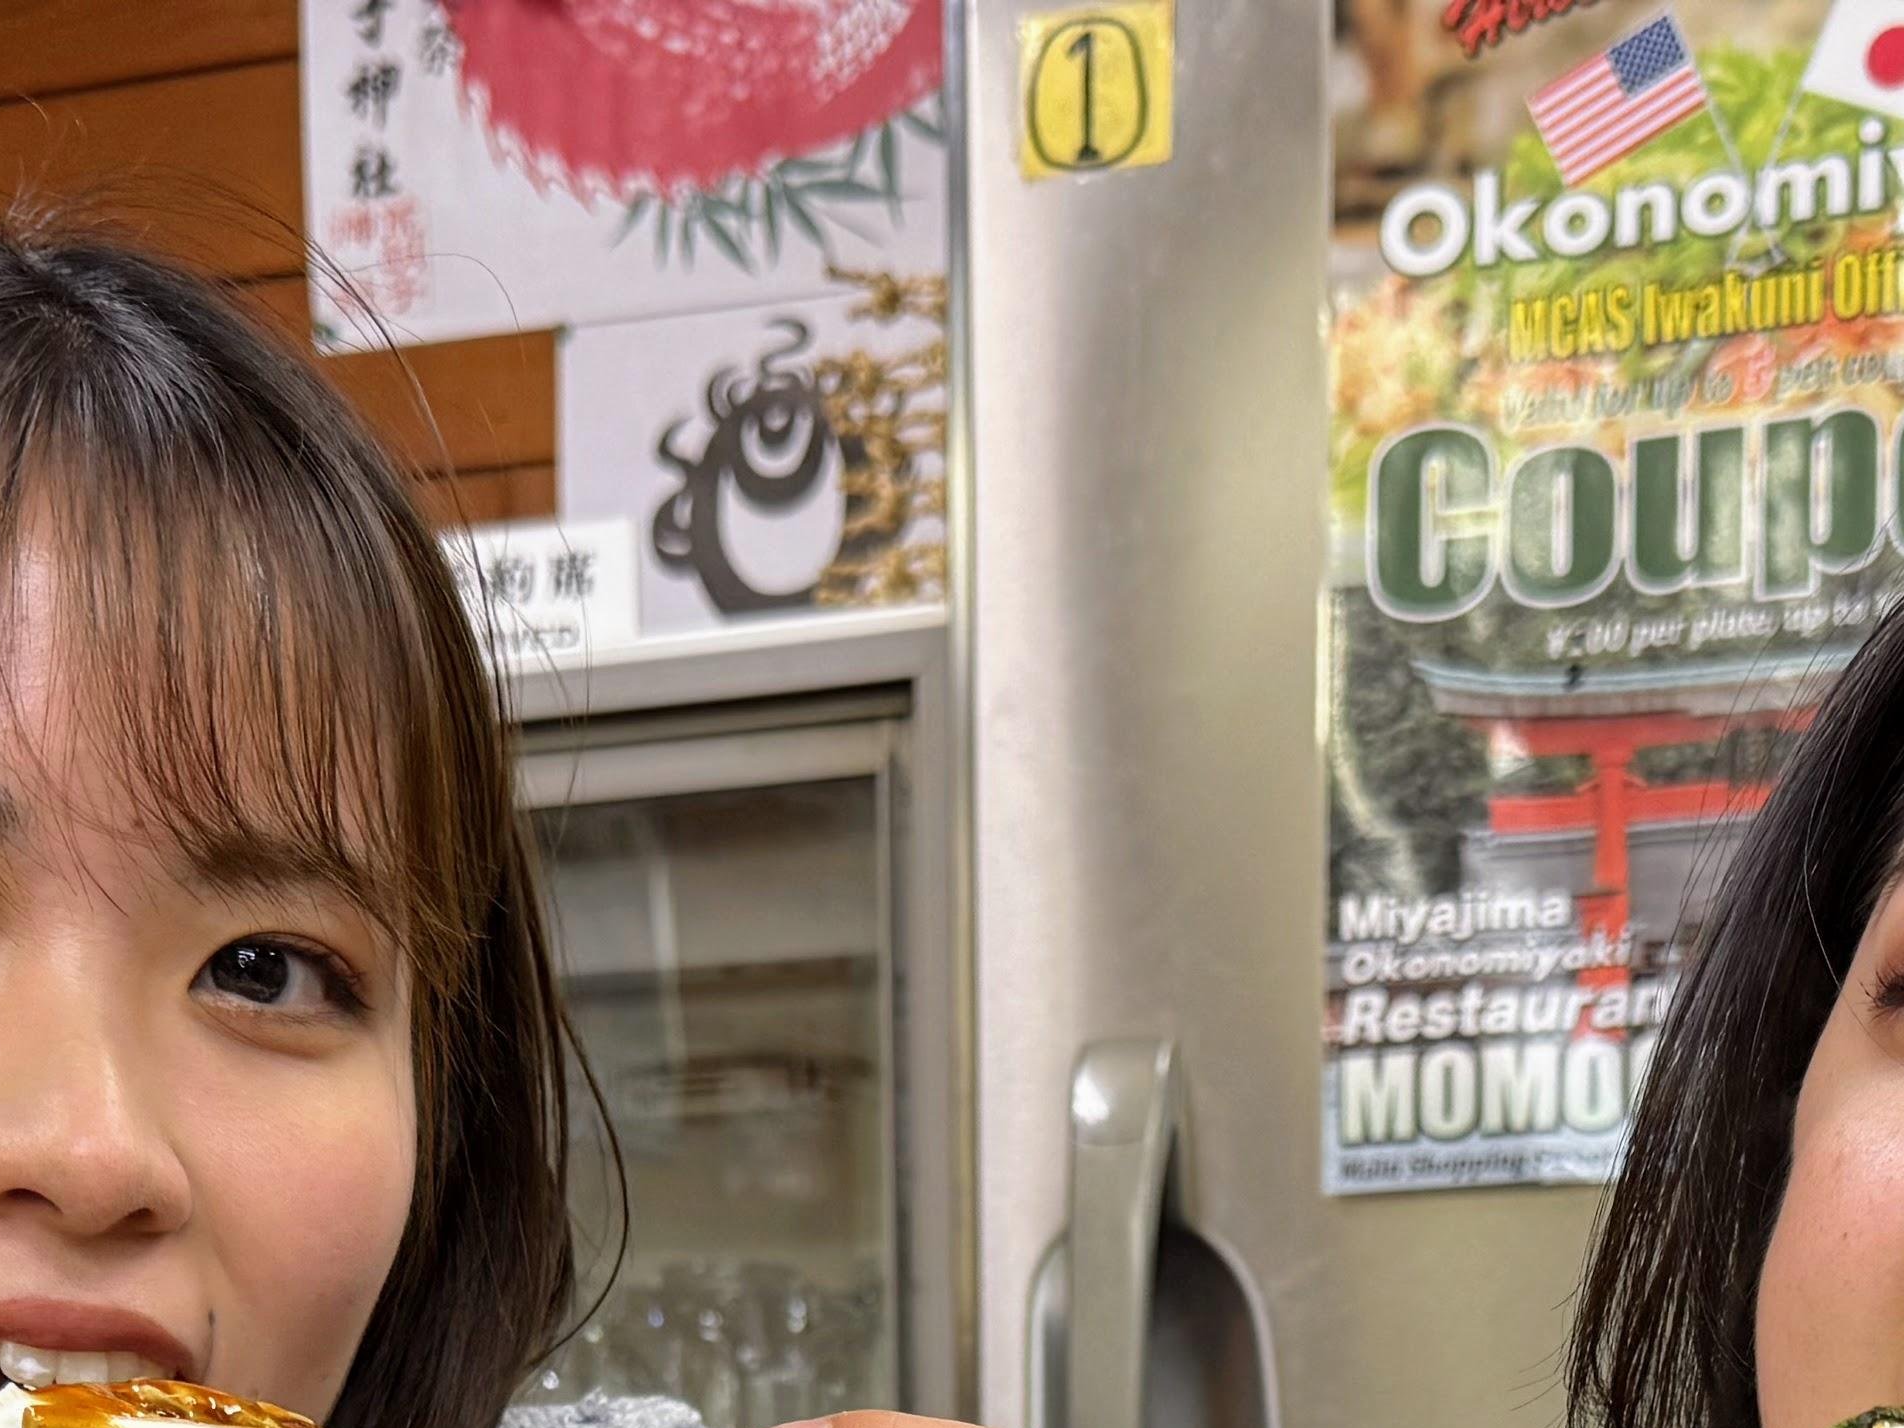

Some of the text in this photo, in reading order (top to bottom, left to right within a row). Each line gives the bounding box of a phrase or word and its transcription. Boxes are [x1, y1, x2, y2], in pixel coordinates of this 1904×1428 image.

[1509, 292, 1636, 363] MCAS
[1640, 264, 1826, 352] Iwakuni
[1339, 892, 1572, 944] Miyajima
[1344, 928, 1633, 985] Okonomiyaki
